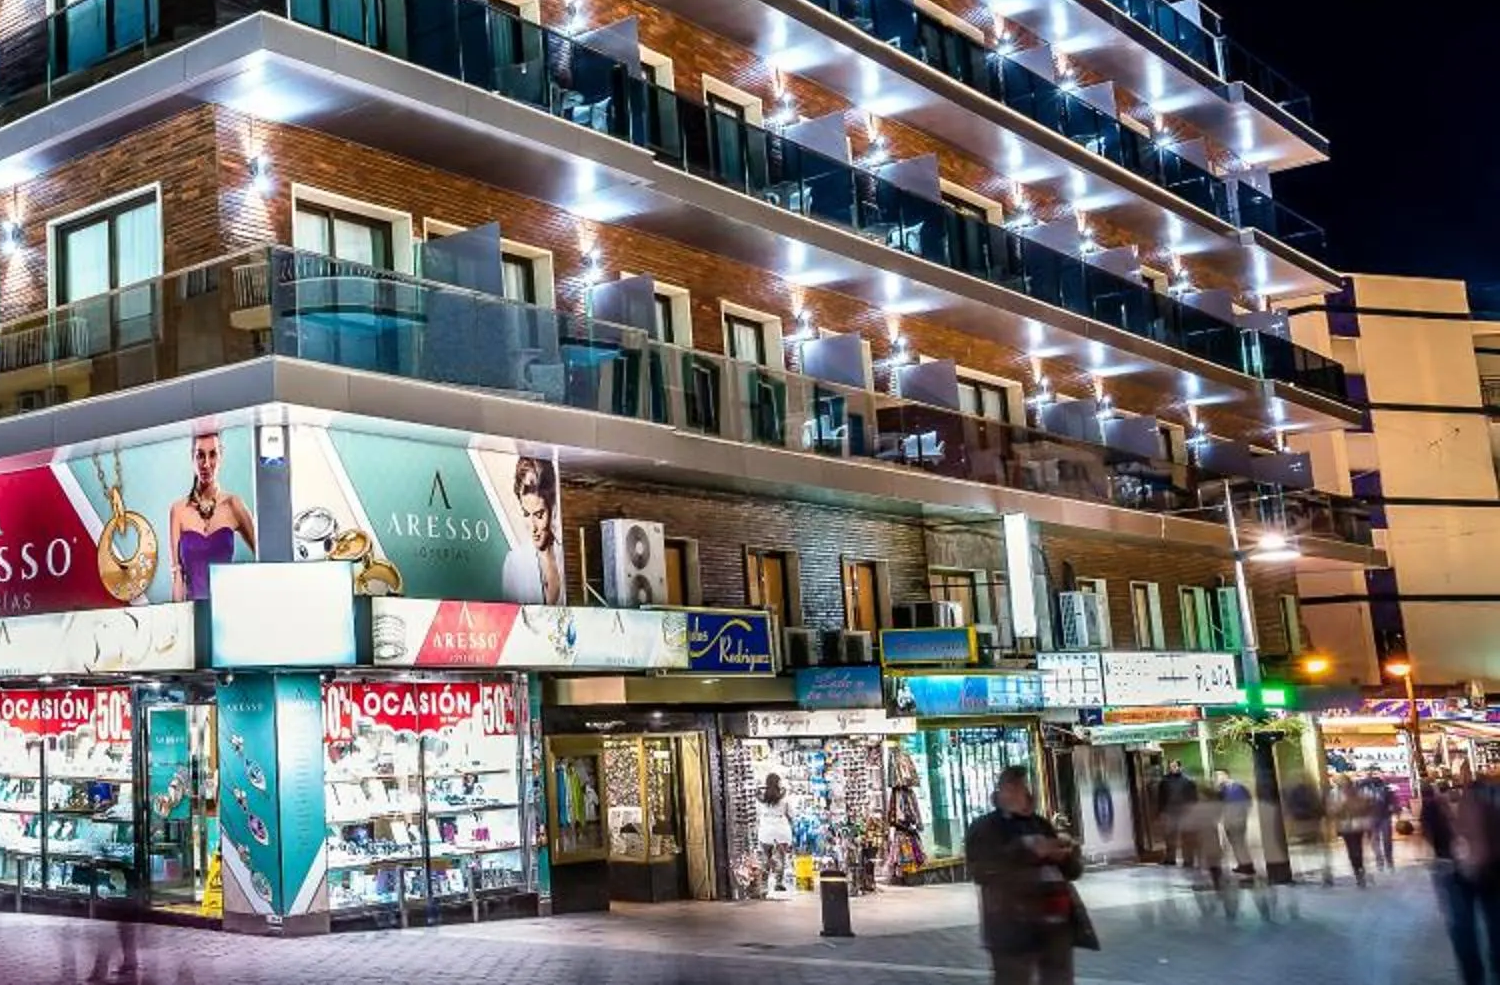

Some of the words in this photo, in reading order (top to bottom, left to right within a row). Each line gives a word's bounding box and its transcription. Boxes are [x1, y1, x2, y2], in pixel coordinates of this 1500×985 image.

[387, 512, 490, 543] ARESSO
[433, 631, 498, 649] ARESSO
[2, 691, 88, 720] OCASIÓN
[363, 684, 471, 715] OCASIÓN
